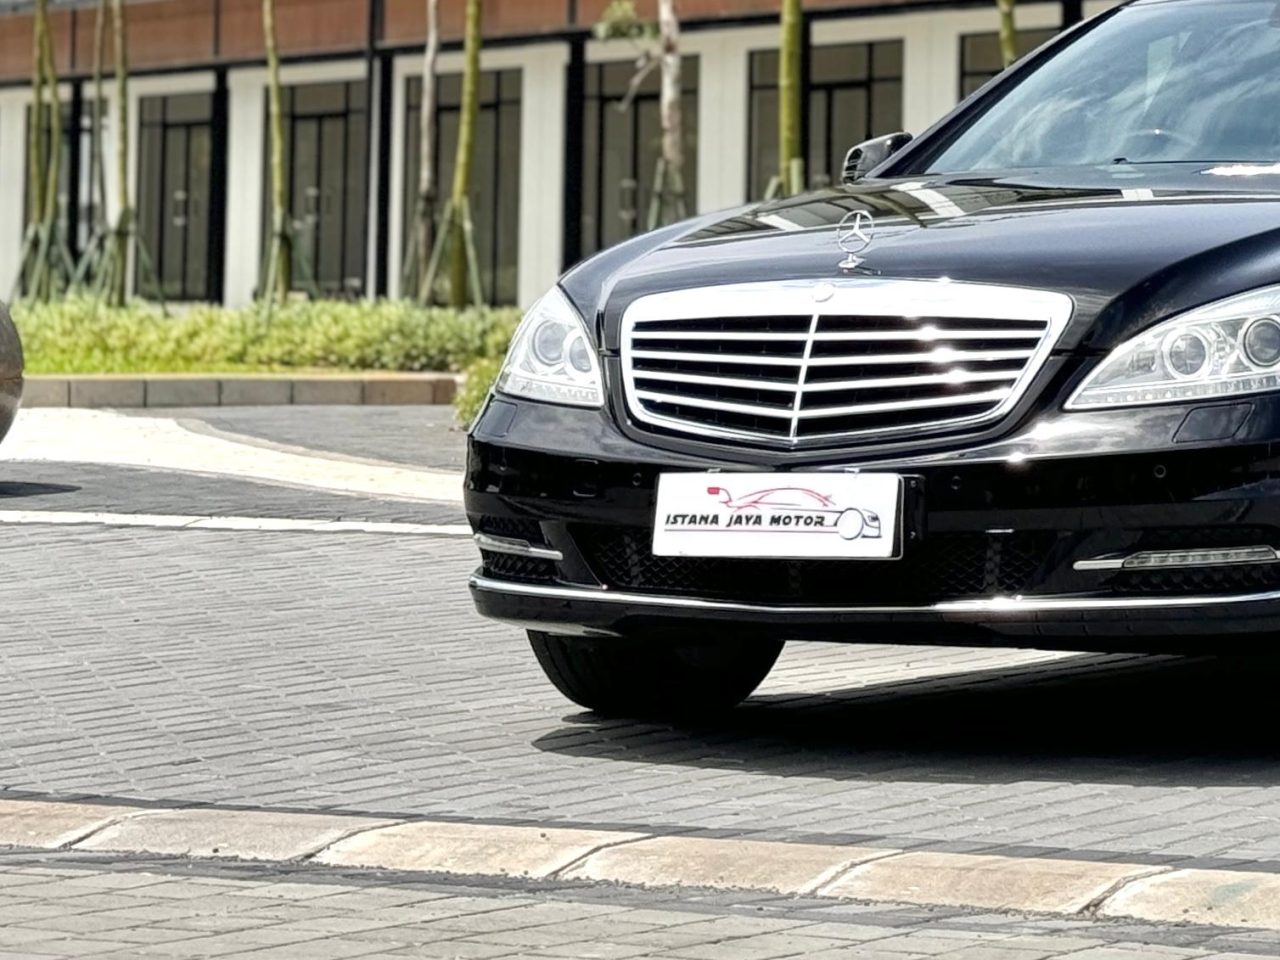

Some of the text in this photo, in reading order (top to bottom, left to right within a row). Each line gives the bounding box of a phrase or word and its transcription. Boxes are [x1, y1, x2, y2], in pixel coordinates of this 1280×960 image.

[665, 514, 825, 528] ISTANA JAYA MOTOR
